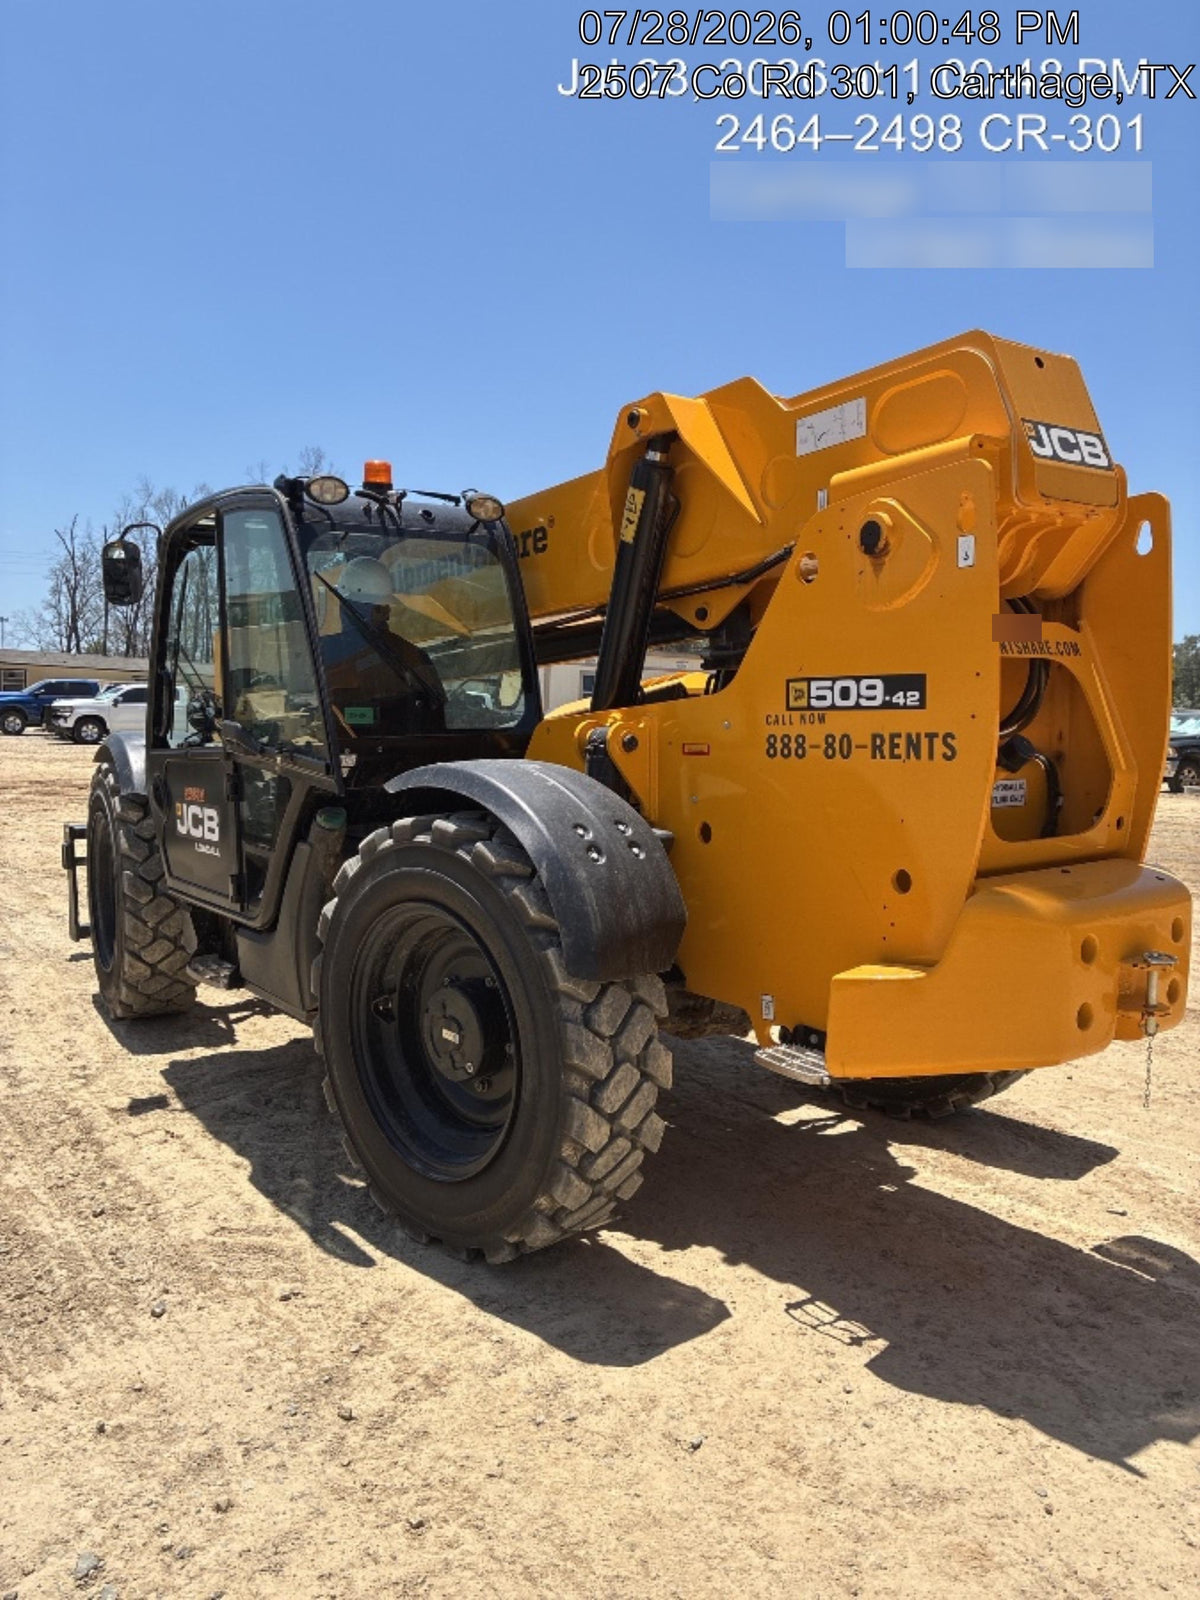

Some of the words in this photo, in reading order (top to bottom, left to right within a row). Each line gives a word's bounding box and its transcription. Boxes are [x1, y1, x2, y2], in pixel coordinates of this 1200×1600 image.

[1030, 424, 1110, 467] JCB
[765, 713, 794, 726] CALL
[799, 712, 828, 724] NOW
[766, 732, 958, 761] 888-80-RENTS
[176, 802, 220, 842] JCB
